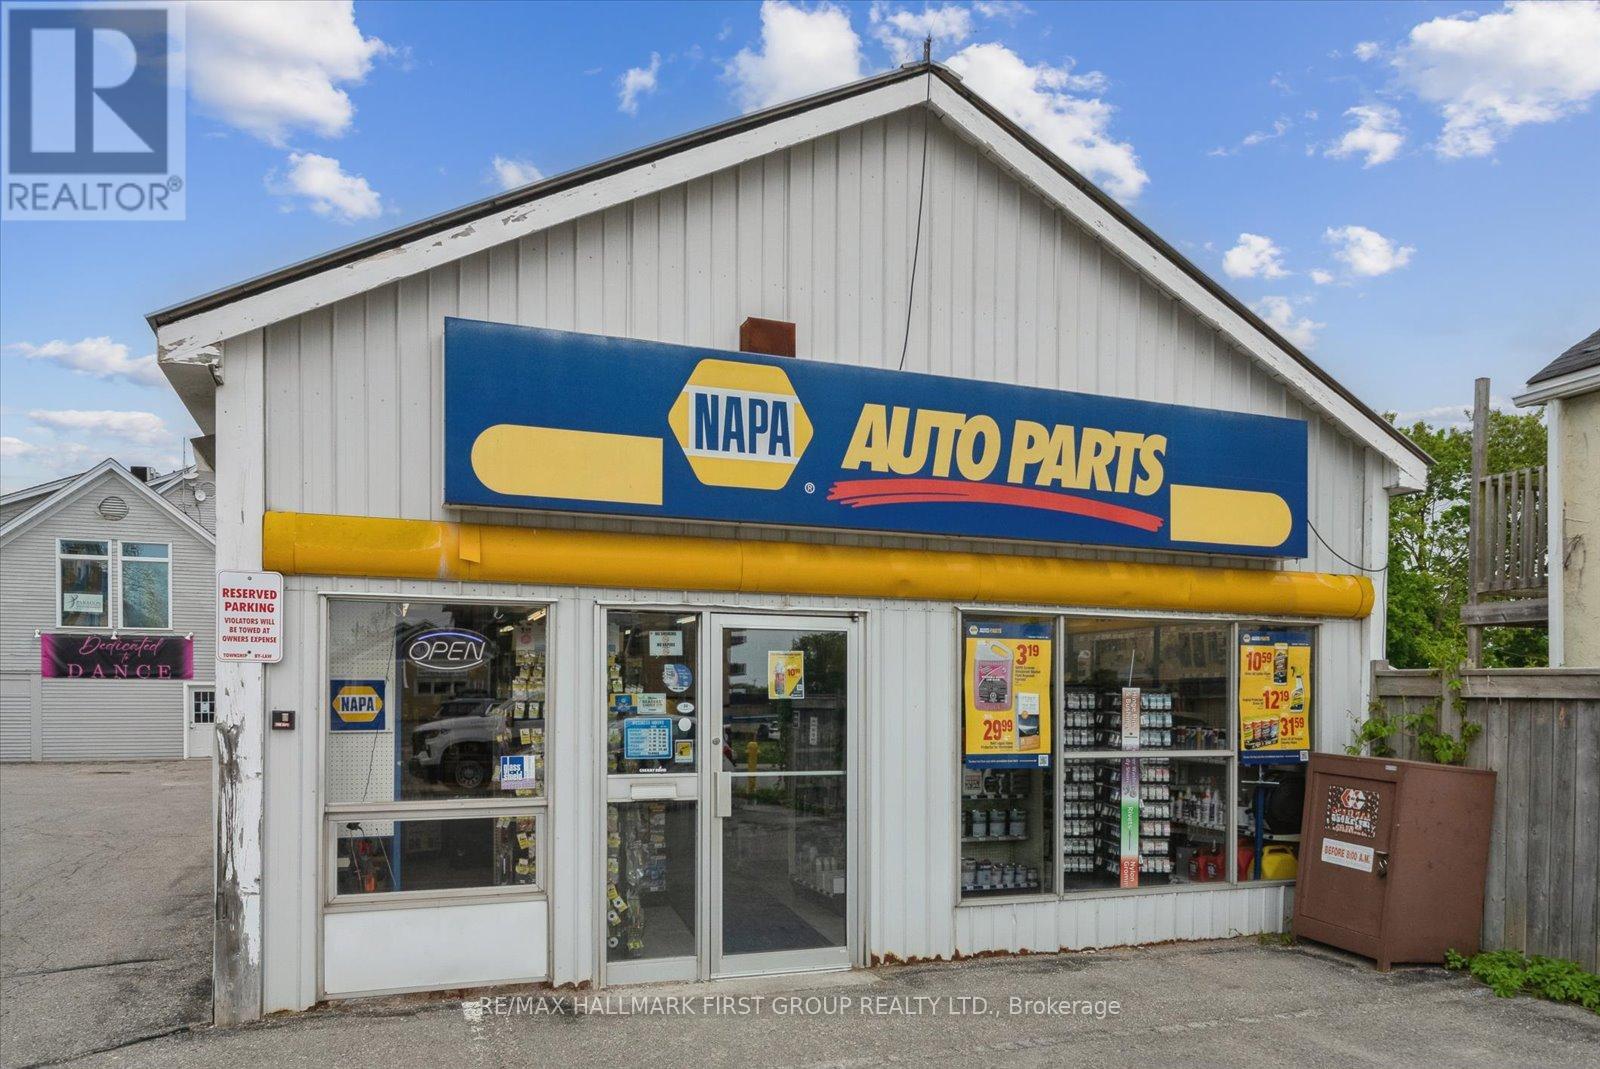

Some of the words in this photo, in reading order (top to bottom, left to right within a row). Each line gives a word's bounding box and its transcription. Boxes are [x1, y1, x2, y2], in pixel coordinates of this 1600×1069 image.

[694, 391, 792, 458] NAPA
[841, 402, 1002, 482] AUTO
[1007, 418, 1168, 497] PARTS
[222, 587, 278, 600] RESERVED
[224, 601, 275, 613] PARKING
[224, 617, 259, 625] VIOLATORS
[260, 618, 275, 626] WILL
[239, 626, 261, 634] TOWED
[78, 636, 165, 657] Dedicated
[222, 635, 249, 643] OWNERS
[250, 636, 277, 644] EXPENSE
[409, 640, 486, 661] OPEN
[66, 663, 172, 679] DANCE
[341, 696, 375, 712] NAPA
[1325, 845, 1345, 858] BEFORE
